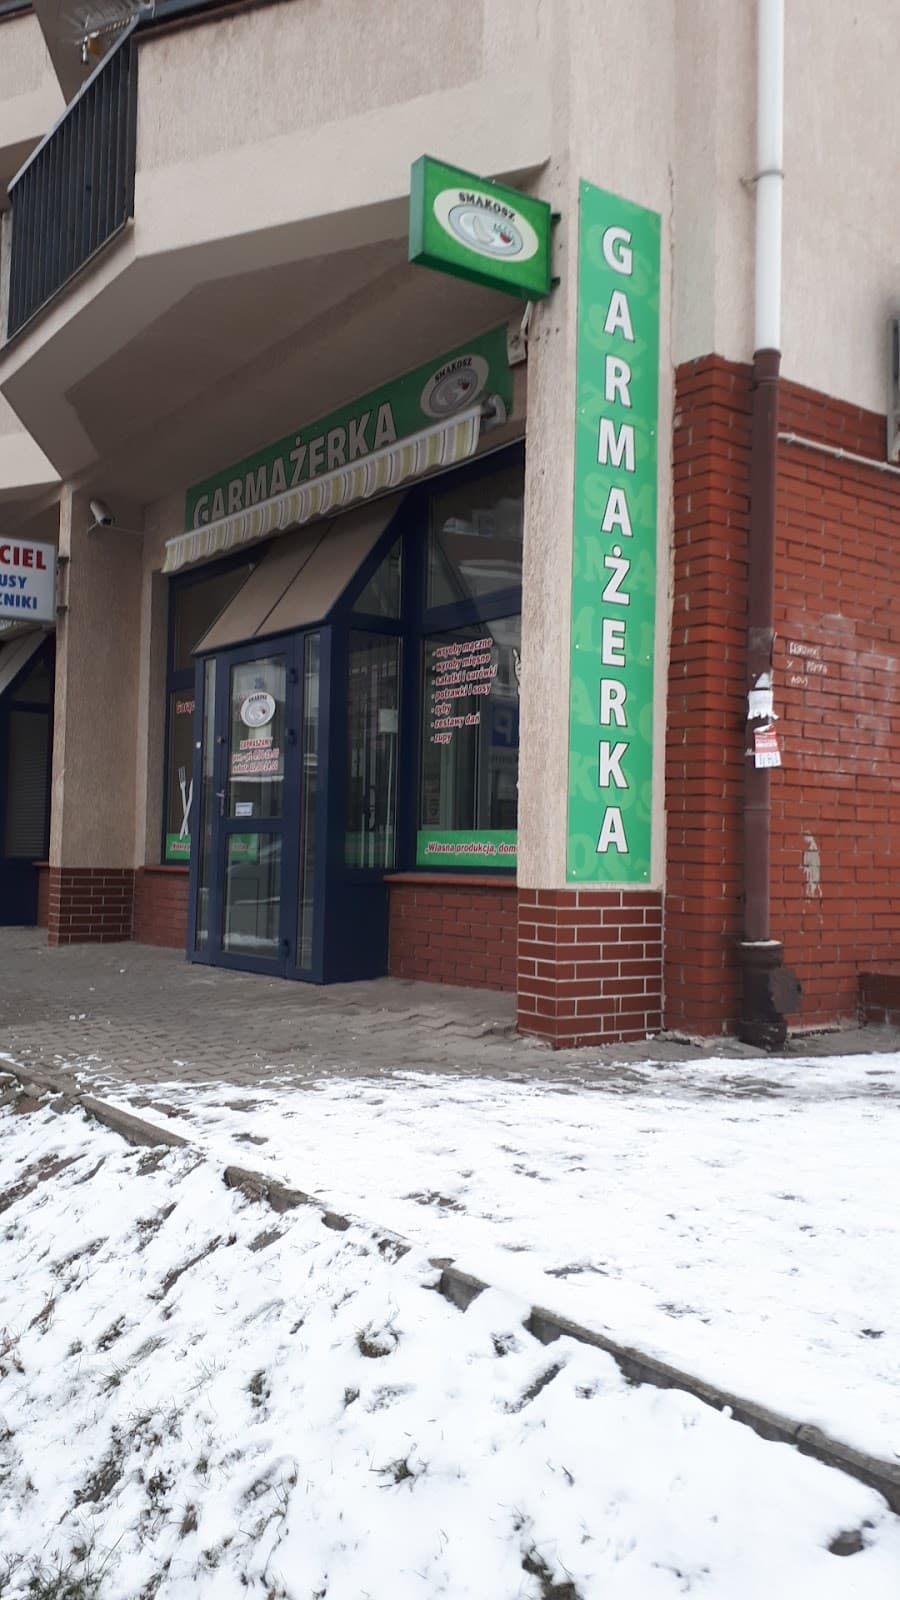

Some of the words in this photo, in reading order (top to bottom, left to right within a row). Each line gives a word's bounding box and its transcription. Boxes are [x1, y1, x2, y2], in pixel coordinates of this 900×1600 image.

[458, 191, 516, 222] SMAKOSZ
[434, 356, 473, 383] SMAKOSZ
[193, 401, 398, 530] GARMAŻERKA
[596, 225, 637, 854] GARMAŻERKA
[0, 544, 46, 571] CIEL
[0, 592, 37, 610] NIKI
[436, 659, 461, 672] wyroby
[462, 653, 490, 667] mięsne
[466, 664, 498, 680] surówki
[435, 685, 467, 701] potrawki
[473, 682, 491, 695] sosy
[435, 703, 451, 715] ryby
[434, 716, 464, 728] zestawy
[465, 712, 480, 725] dań
[434, 733, 452, 744] zupy
[456, 842, 497, 856] produkcja,
[498, 842, 518, 854] dom
